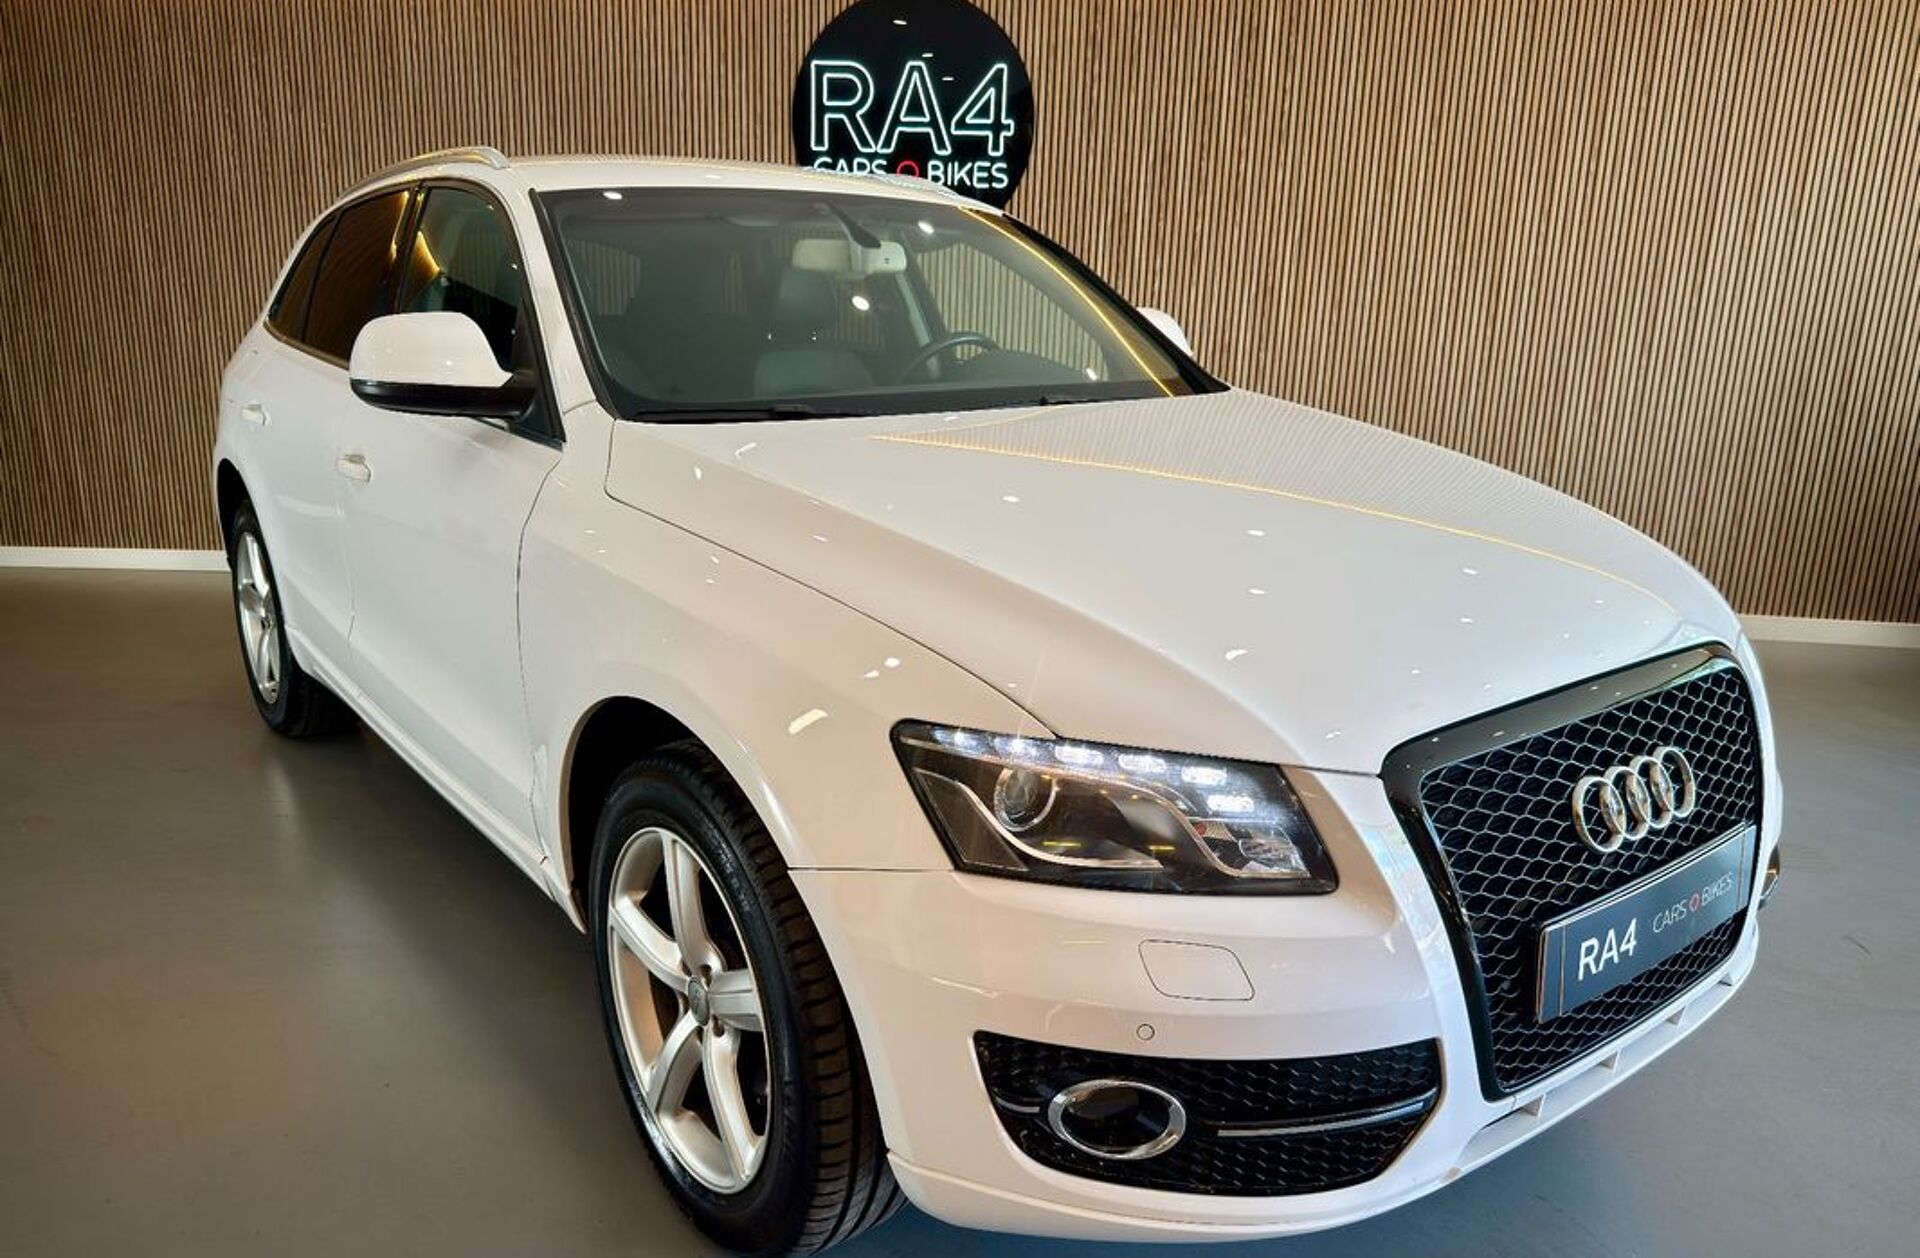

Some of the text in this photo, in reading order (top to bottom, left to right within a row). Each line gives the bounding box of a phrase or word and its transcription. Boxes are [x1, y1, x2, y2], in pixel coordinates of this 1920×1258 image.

[810, 60, 1015, 157] RA4
[927, 160, 1009, 189] BIKES
[1577, 871, 1735, 981] RA4 CARS BIKES
